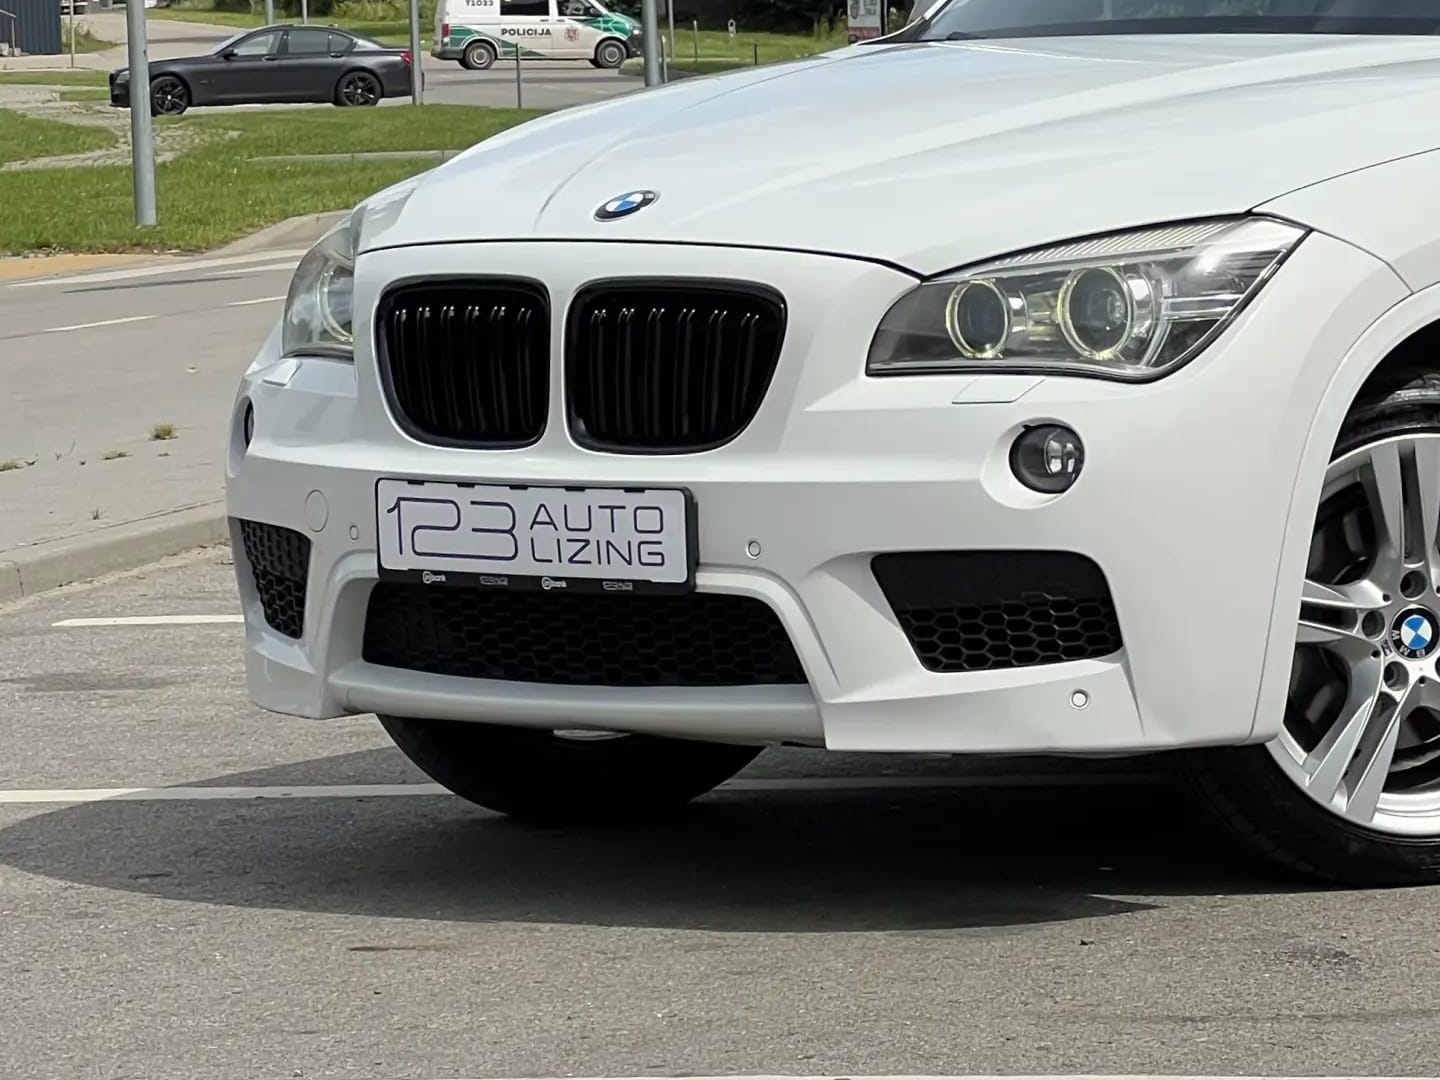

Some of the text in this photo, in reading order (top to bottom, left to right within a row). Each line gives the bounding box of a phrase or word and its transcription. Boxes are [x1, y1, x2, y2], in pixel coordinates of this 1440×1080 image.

[501, 28, 552, 36] POLICIJA
[387, 496, 519, 561] 123
[530, 503, 664, 533] AUTO
[530, 537, 665, 567] LIZING
